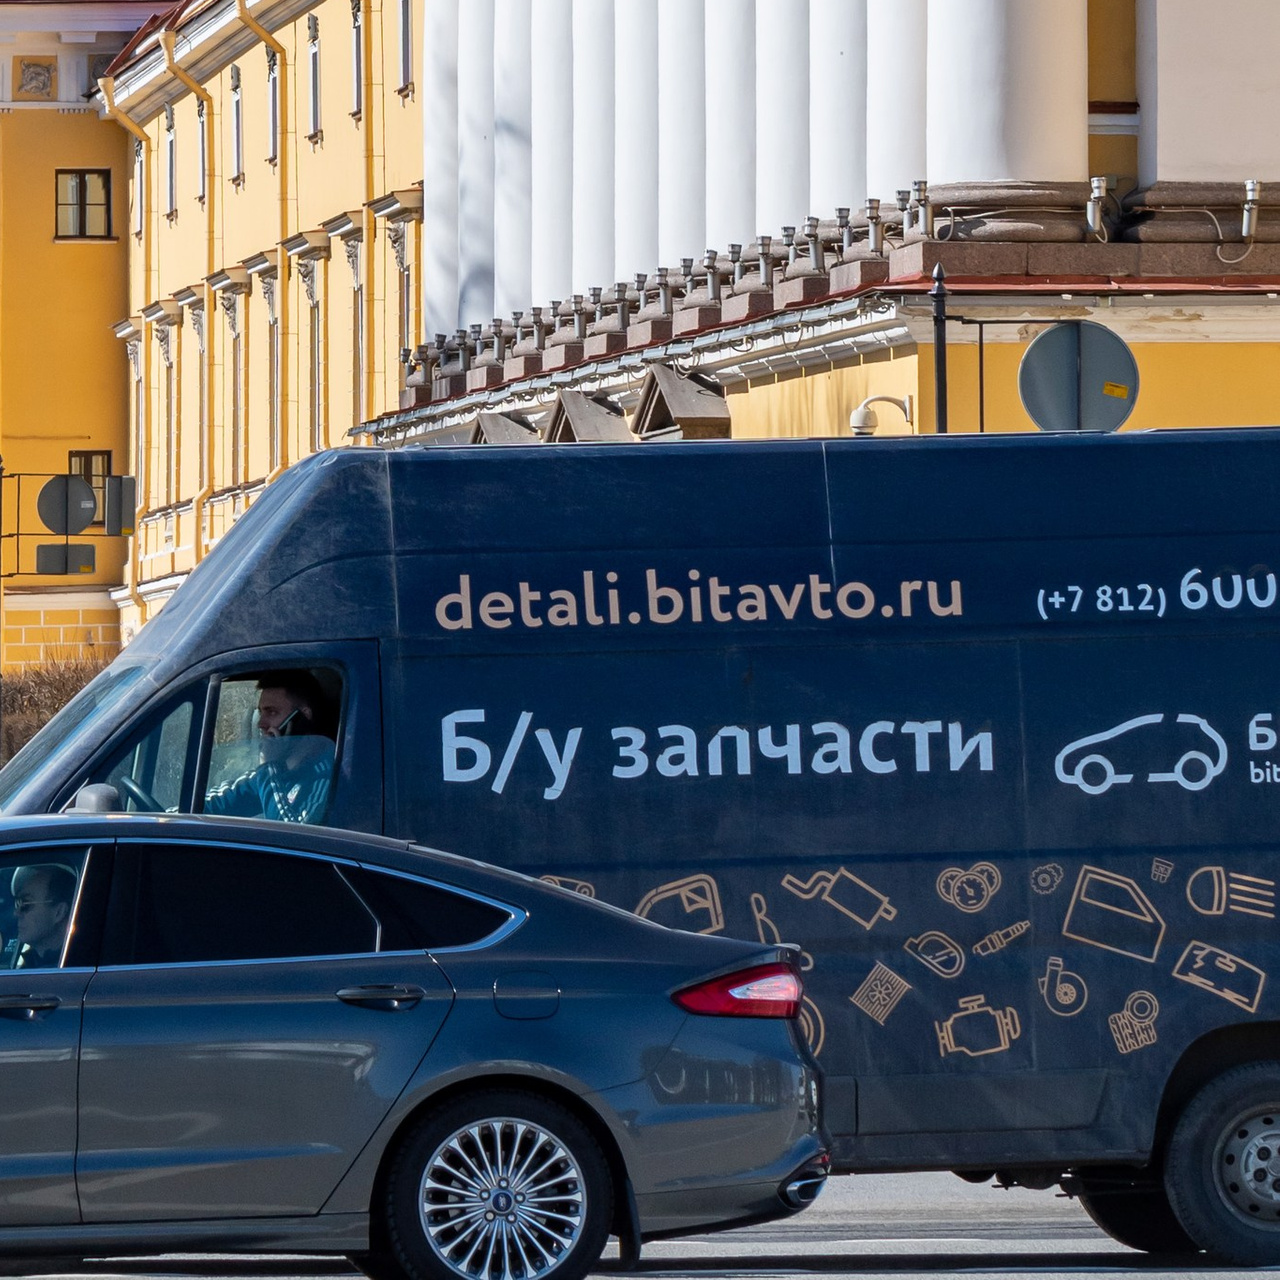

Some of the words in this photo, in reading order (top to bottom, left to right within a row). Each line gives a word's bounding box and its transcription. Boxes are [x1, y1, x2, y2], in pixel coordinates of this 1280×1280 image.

[434, 568, 963, 630] detali.bitavto.ru
[1036, 585, 1084, 620] (+7
[1096, 583, 1167, 618] 812)
[441, 708, 583, 801] Б/у
[610, 719, 995, 780] запчасти
